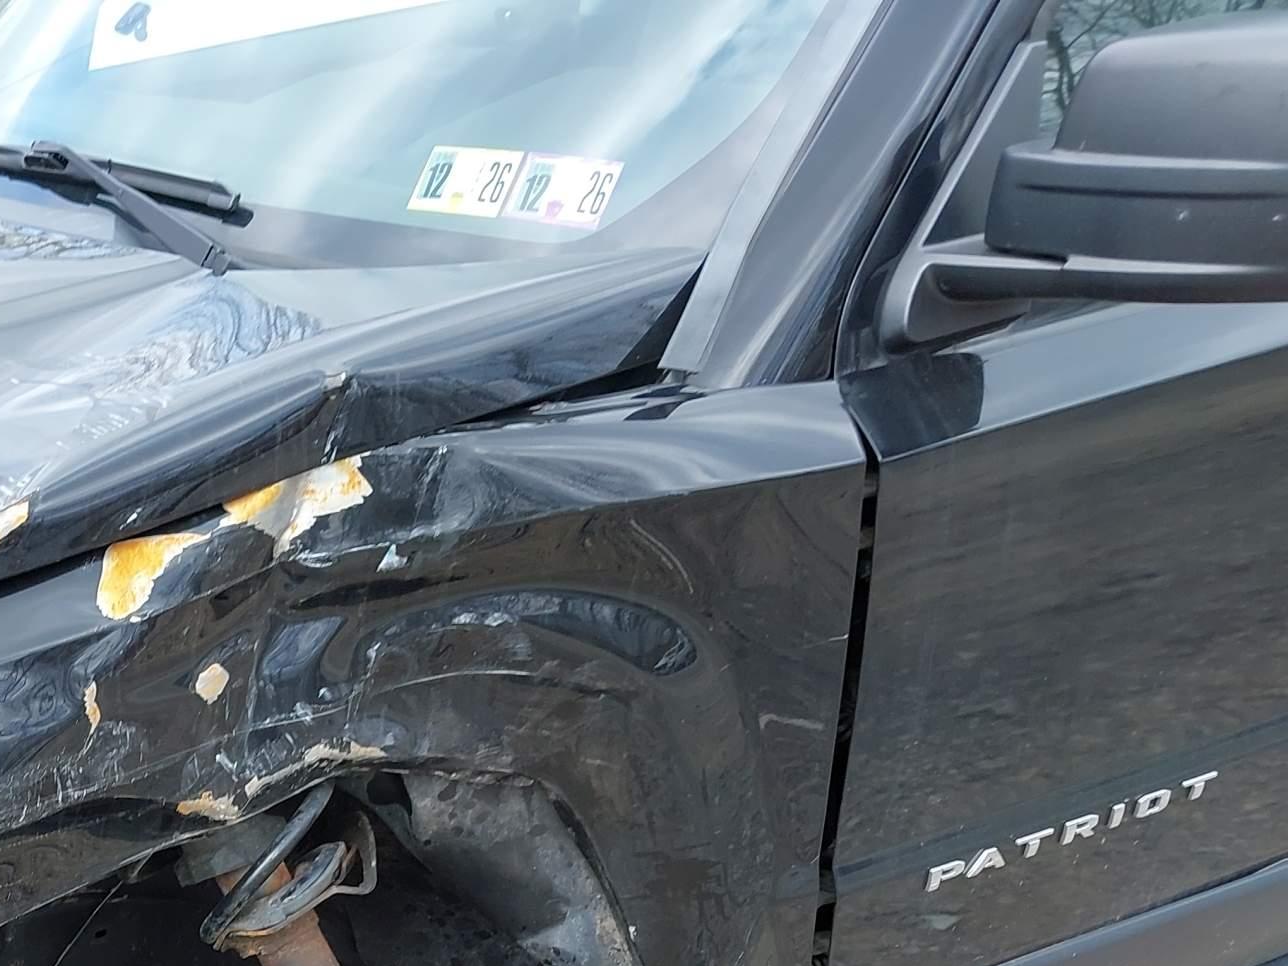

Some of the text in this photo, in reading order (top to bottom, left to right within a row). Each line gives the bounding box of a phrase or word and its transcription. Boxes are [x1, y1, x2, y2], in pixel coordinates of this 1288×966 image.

[423, 161, 513, 203] 12 26
[519, 170, 614, 214] 12 26
[924, 770, 1219, 893] PATRIOT
